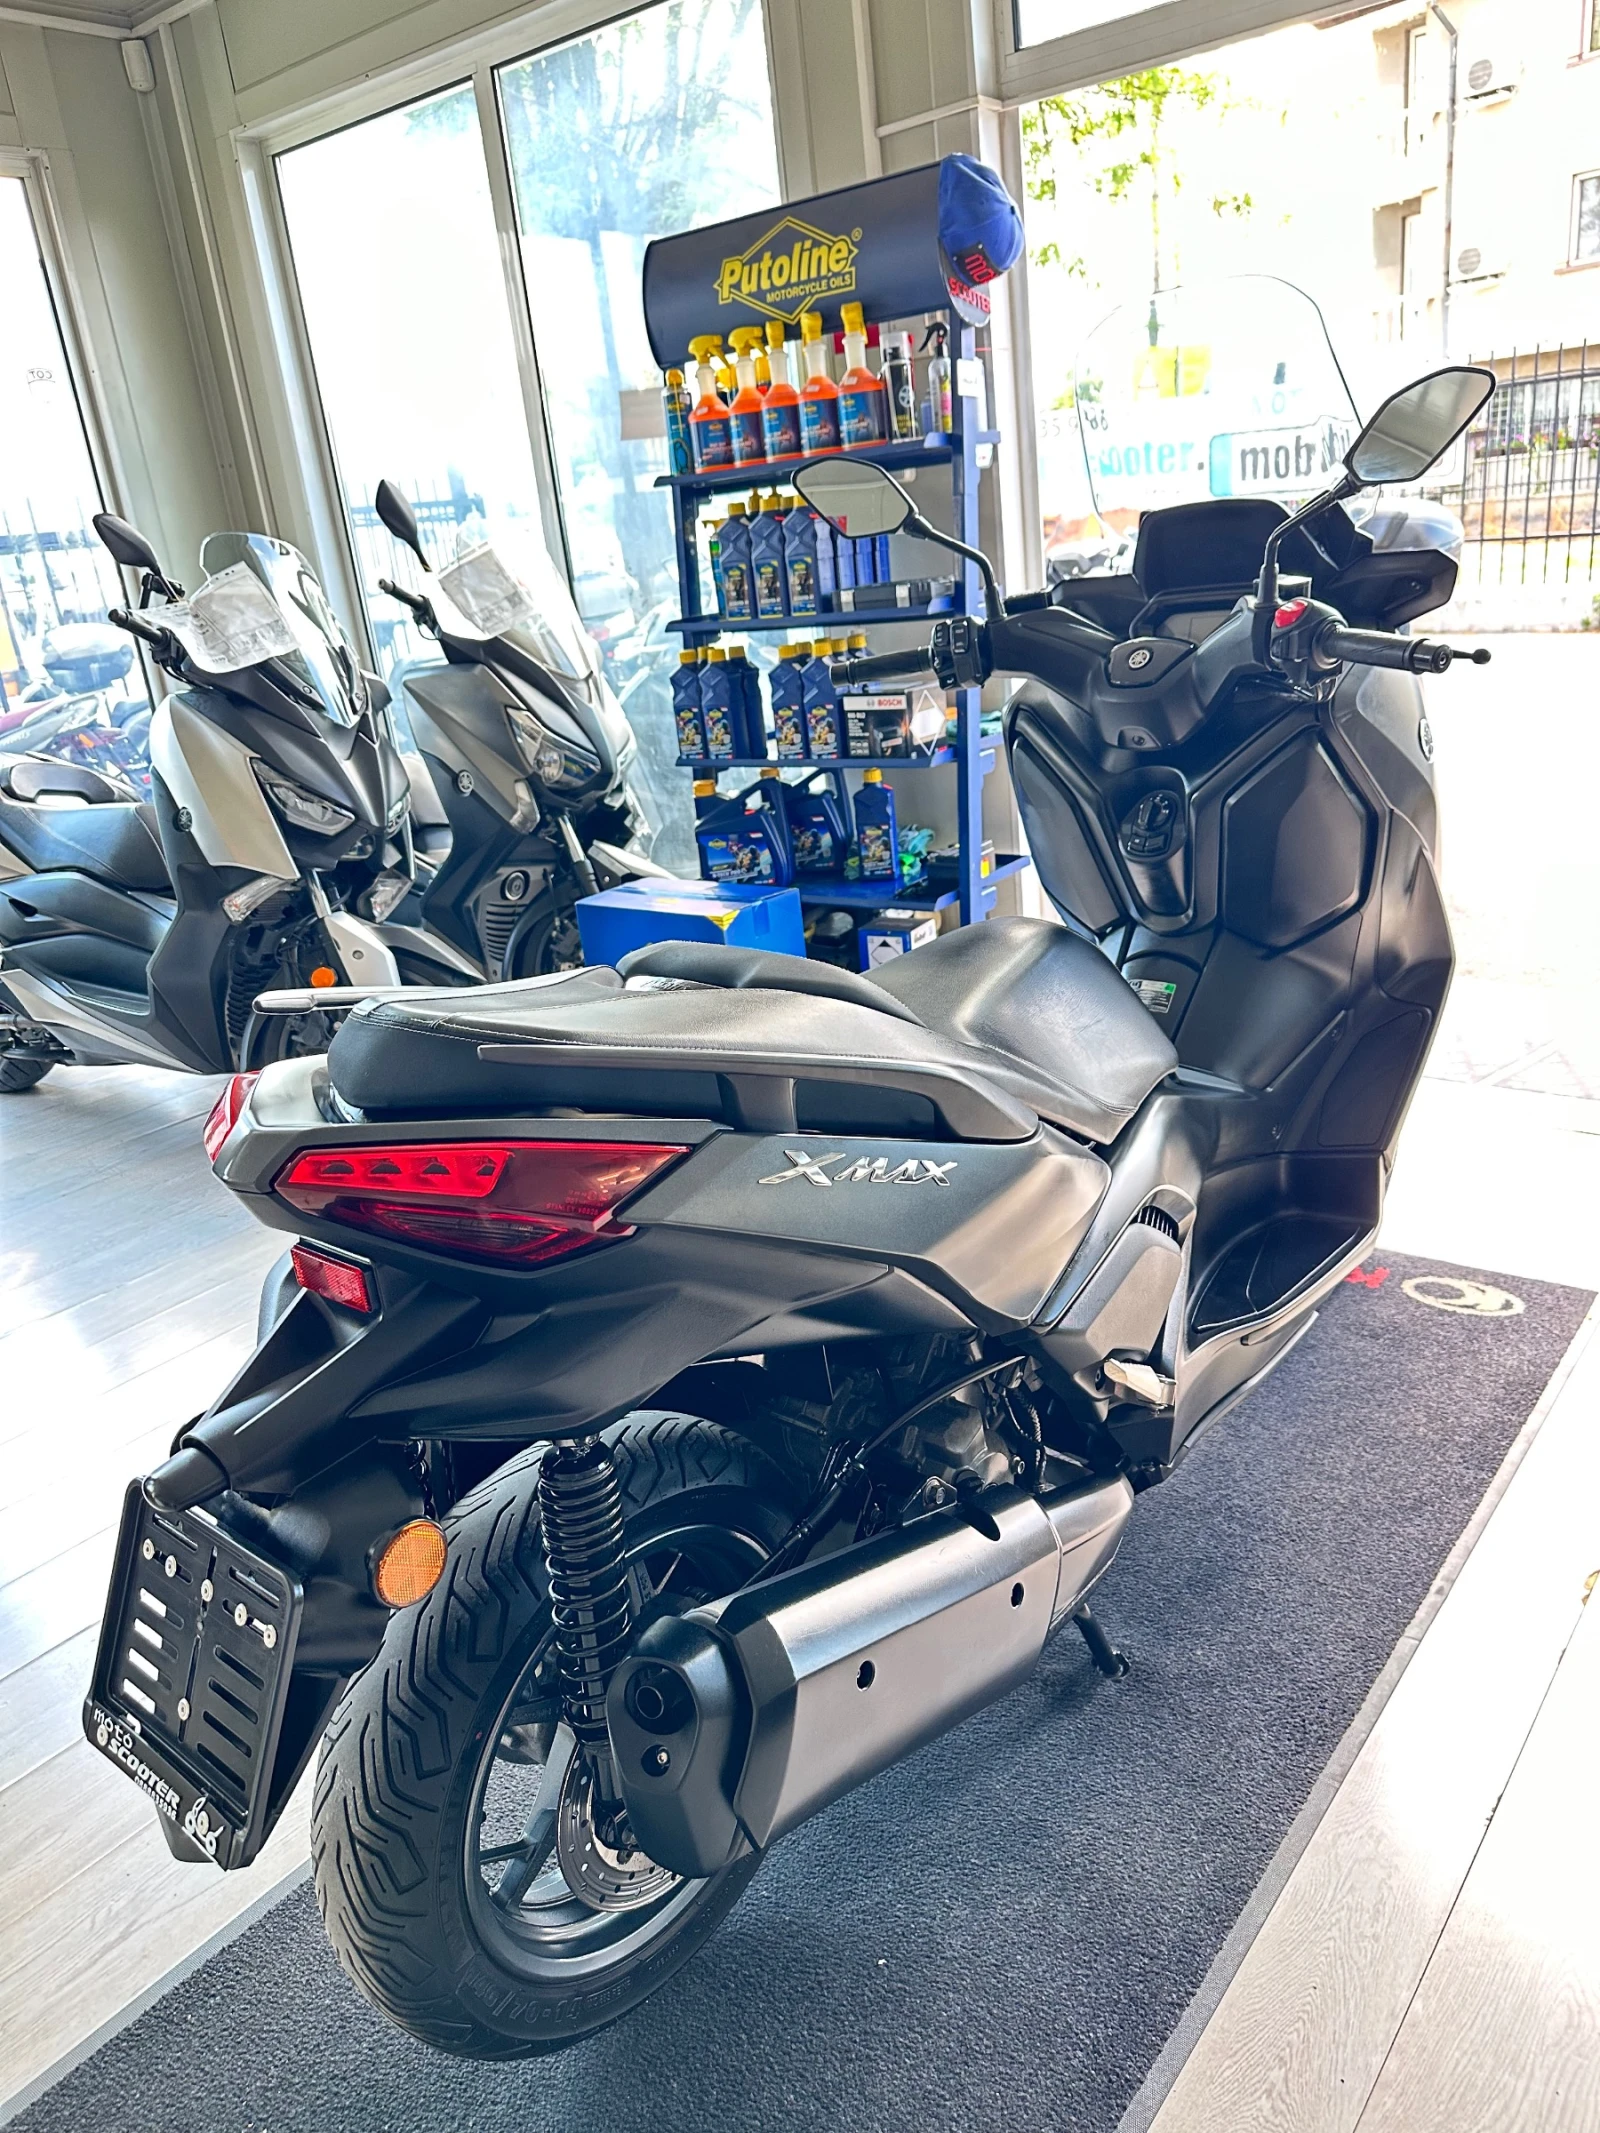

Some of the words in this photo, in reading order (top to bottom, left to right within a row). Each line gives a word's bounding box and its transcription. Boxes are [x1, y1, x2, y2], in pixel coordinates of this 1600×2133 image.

[721, 238, 850, 299] Putoline
[766, 277, 828, 303] MOTORCYCLE
[829, 273, 851, 290] OILS
[94, 1708, 133, 1749] moto
[108, 1737, 181, 1810] SCOOTER
